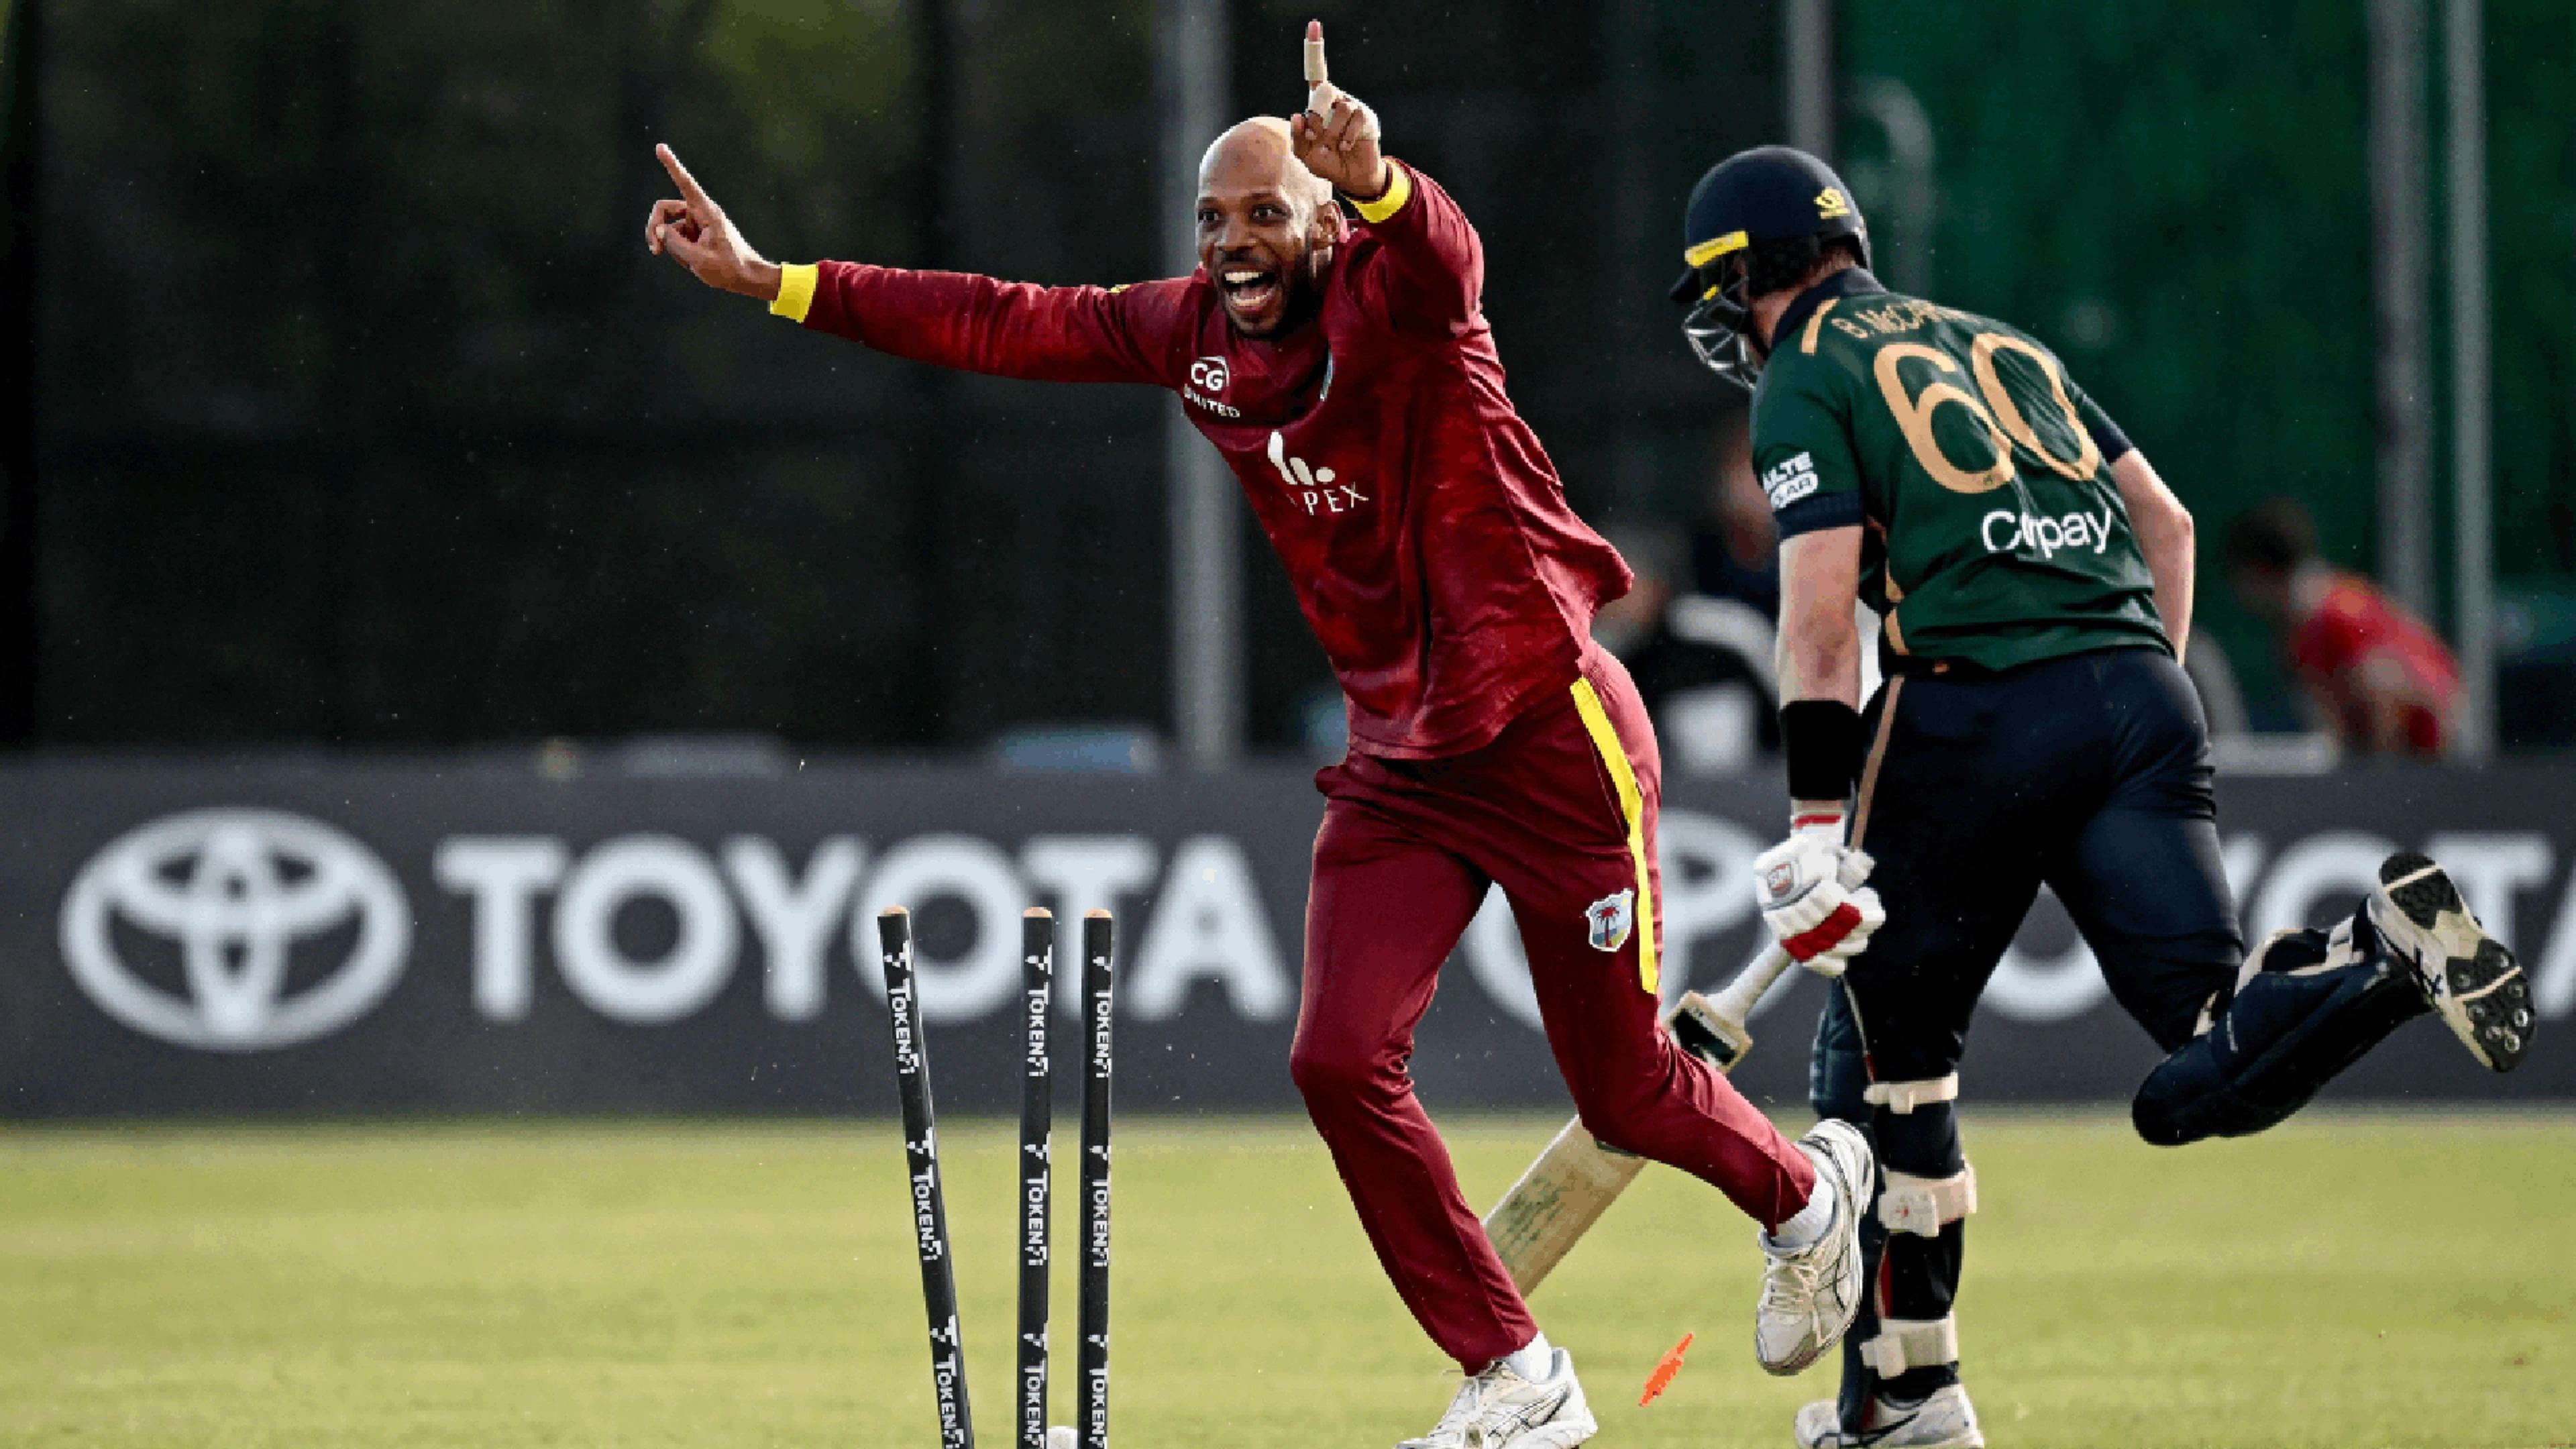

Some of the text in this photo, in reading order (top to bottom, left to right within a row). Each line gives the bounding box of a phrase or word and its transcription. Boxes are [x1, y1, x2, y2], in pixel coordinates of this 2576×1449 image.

[1191, 361, 1223, 391] CG
[1874, 332, 2099, 494] 60
[1287, 482, 1369, 516] PEX
[436, 836, 1295, 1020] TOYOTA
[1024, 1358, 1045, 1449] TOKENF
[1088, 1361, 1108, 1449] TOKENF
